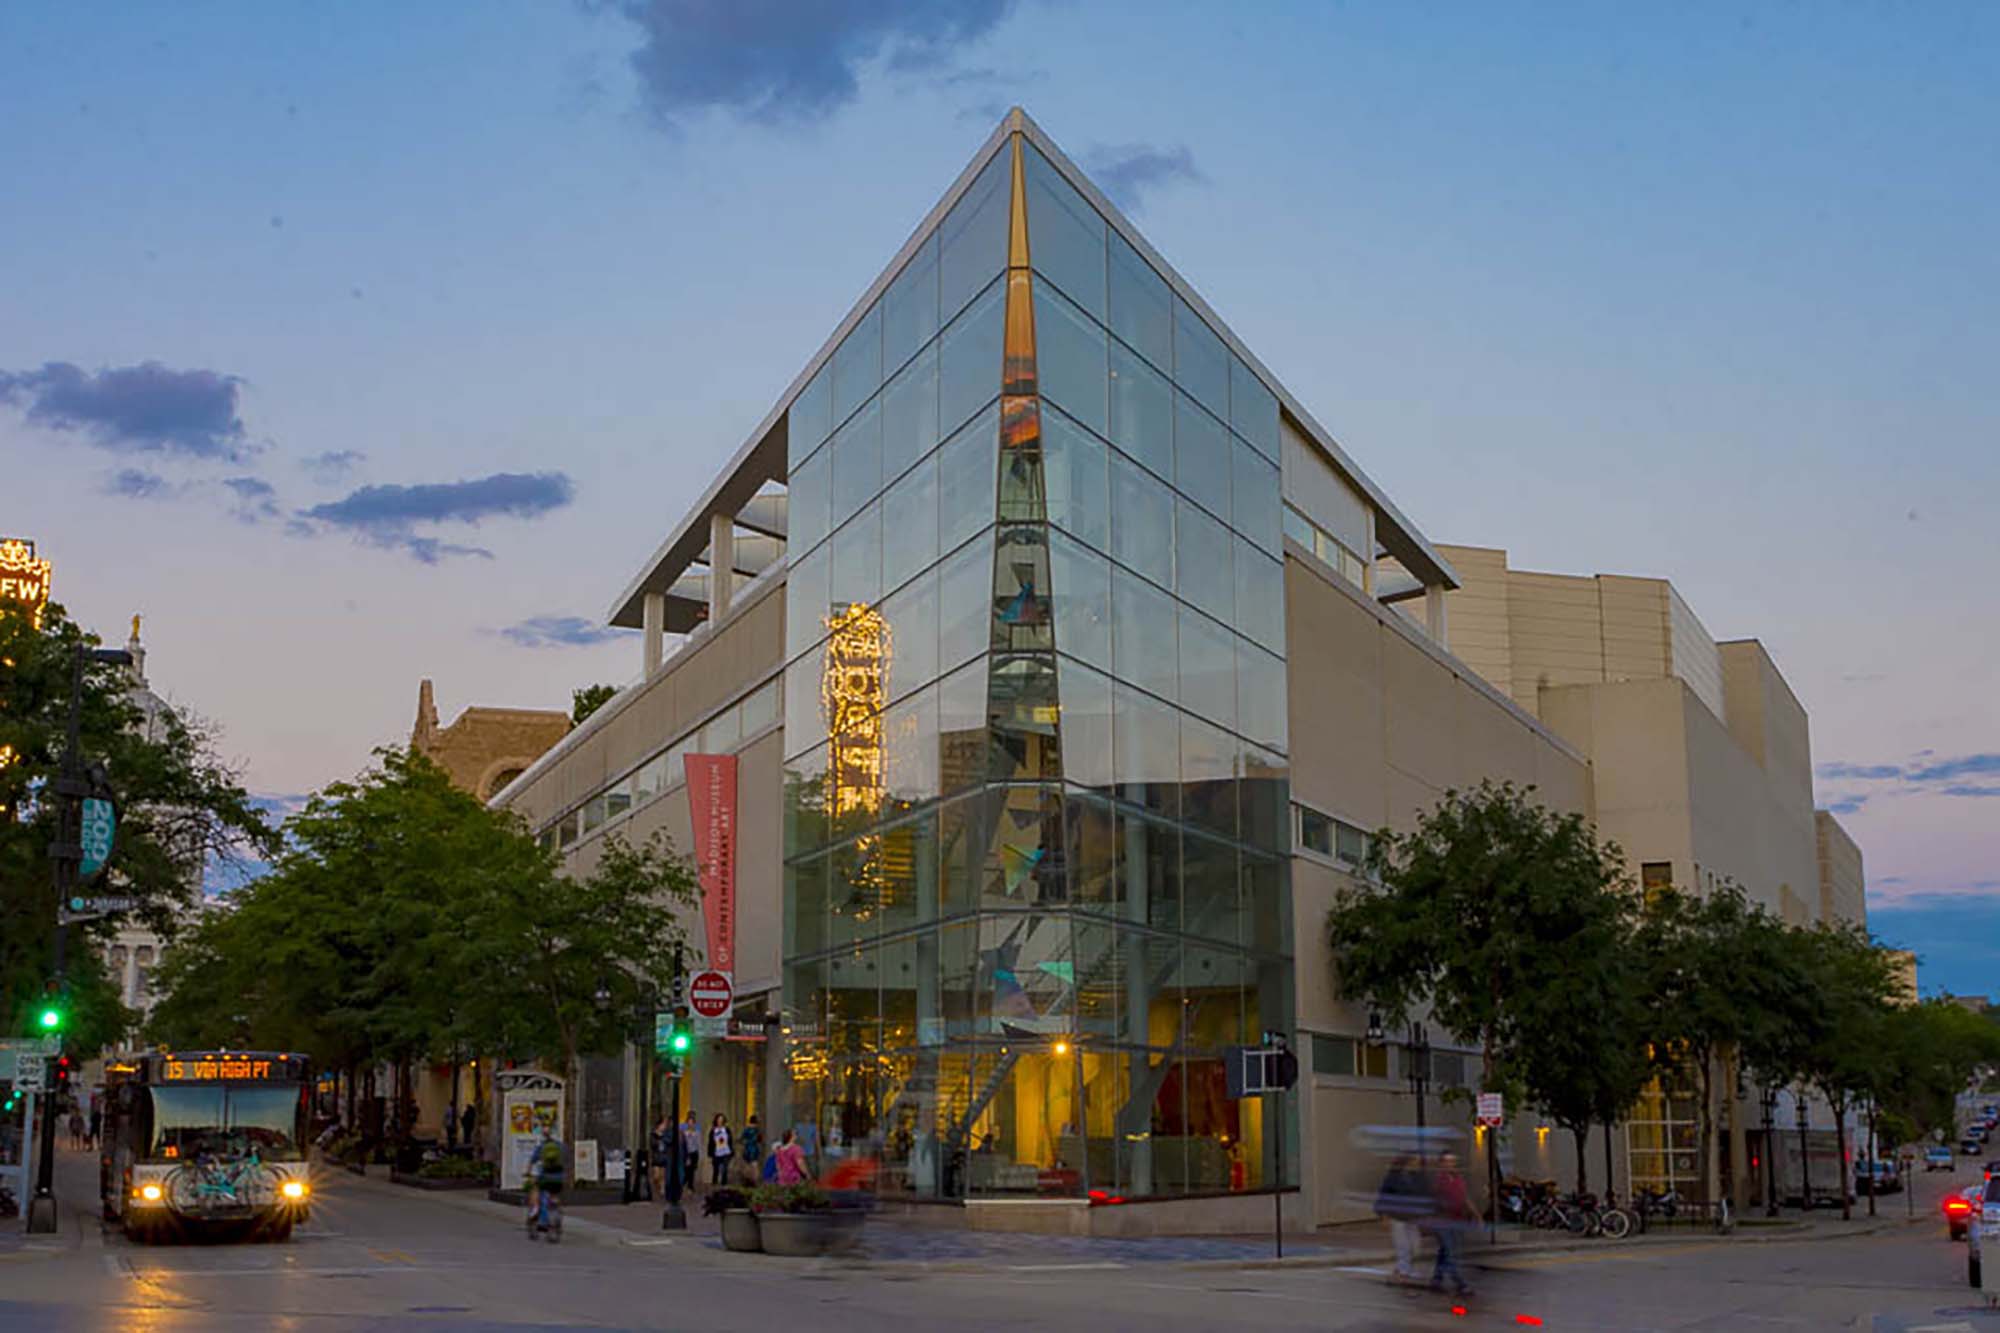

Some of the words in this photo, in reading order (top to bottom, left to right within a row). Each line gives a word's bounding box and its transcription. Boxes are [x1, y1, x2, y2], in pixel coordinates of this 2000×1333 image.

[710, 765, 721, 816] MUSEUM
[720, 806, 729, 828] ART
[92, 800, 111, 861] 200
[709, 818, 720, 877] MADISON
[720, 834, 729, 942] CONTEMPORARY
[719, 947, 728, 963] OF
[697, 980, 708, 988] DO
[710, 980, 724, 988] NOT
[20, 1055, 41, 1066] ONE
[194, 1061, 217, 1079] VIA
[220, 1061, 251, 1079] HIGH
[252, 1061, 271, 1079] PT
[19, 1067, 42, 1077] WAY
